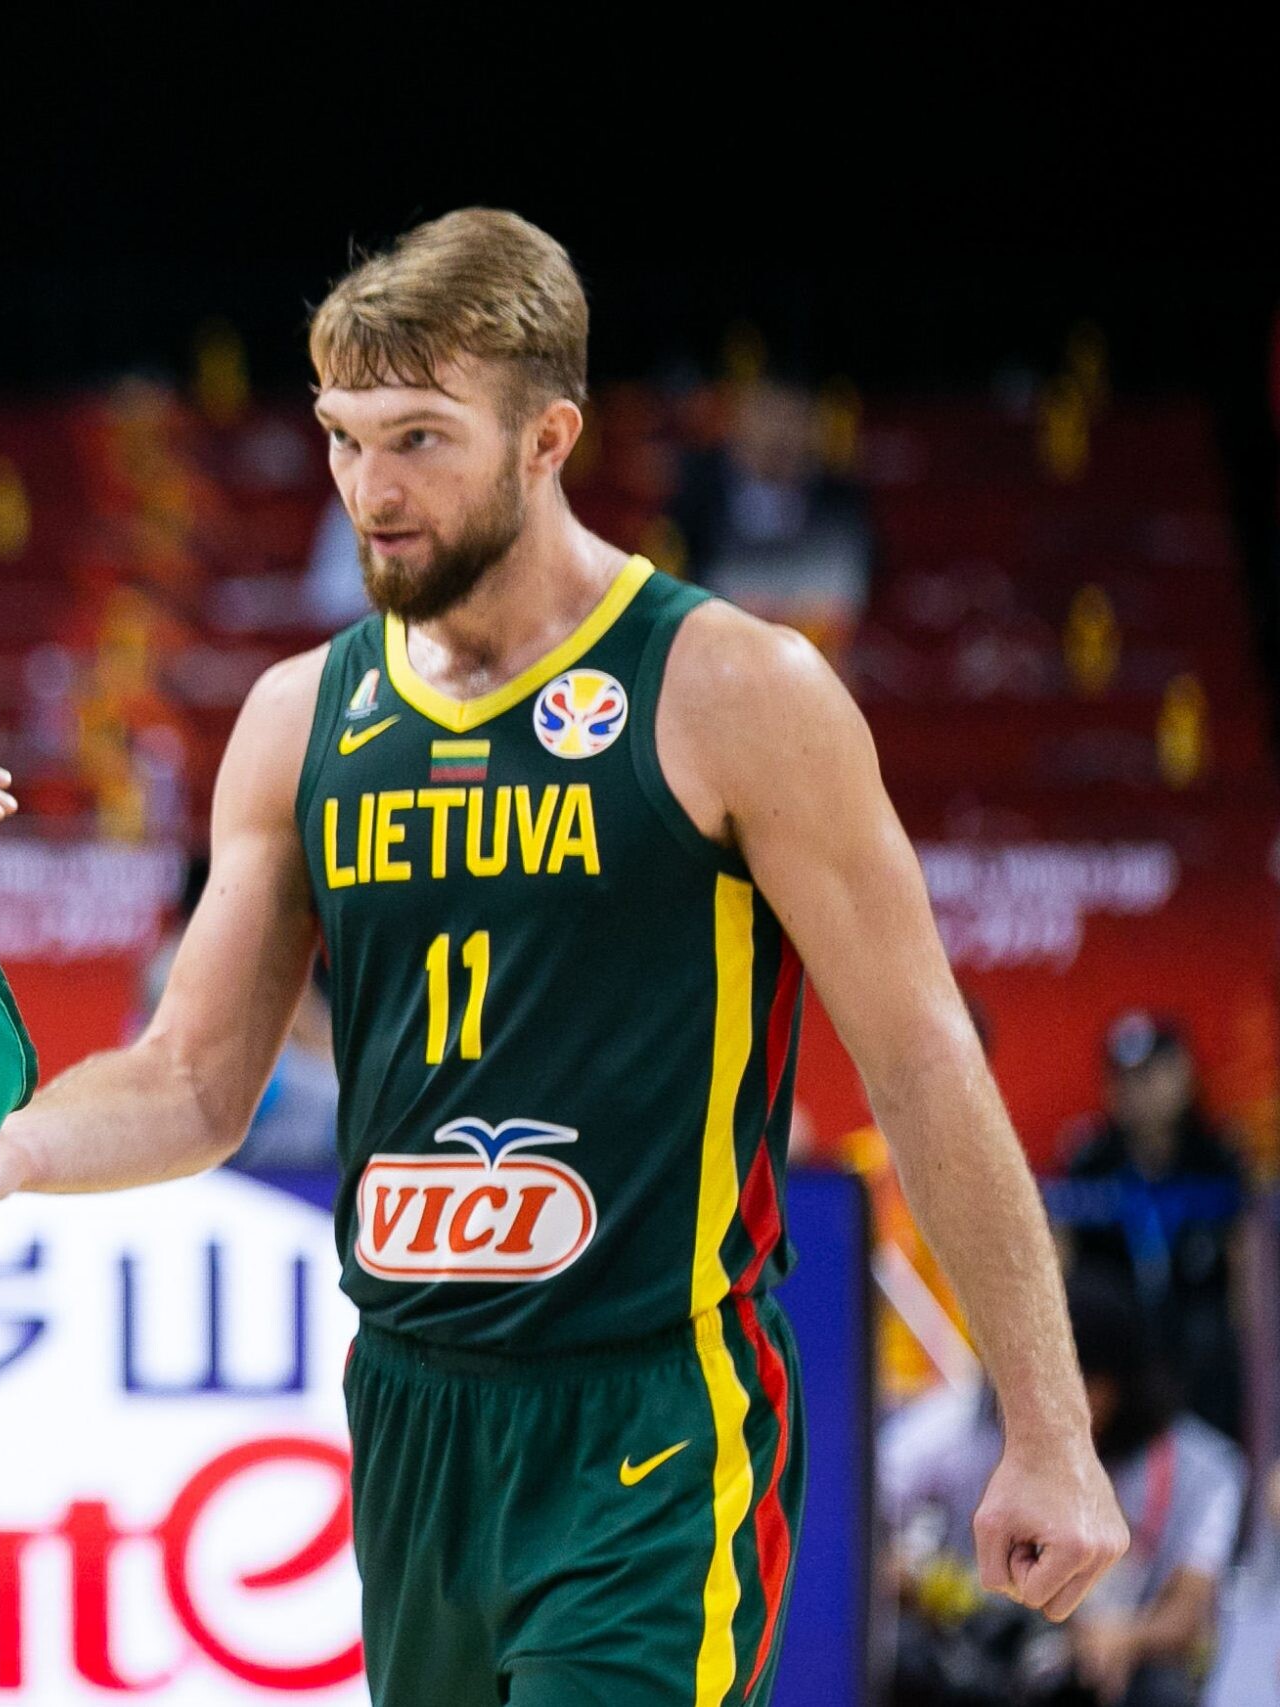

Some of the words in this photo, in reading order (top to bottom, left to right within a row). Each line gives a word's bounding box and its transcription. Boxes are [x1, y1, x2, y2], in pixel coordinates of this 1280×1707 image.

[323, 783, 600, 889] LIETUVA
[425, 930, 490, 1066] 11
[373, 1186, 557, 1254] VICI
